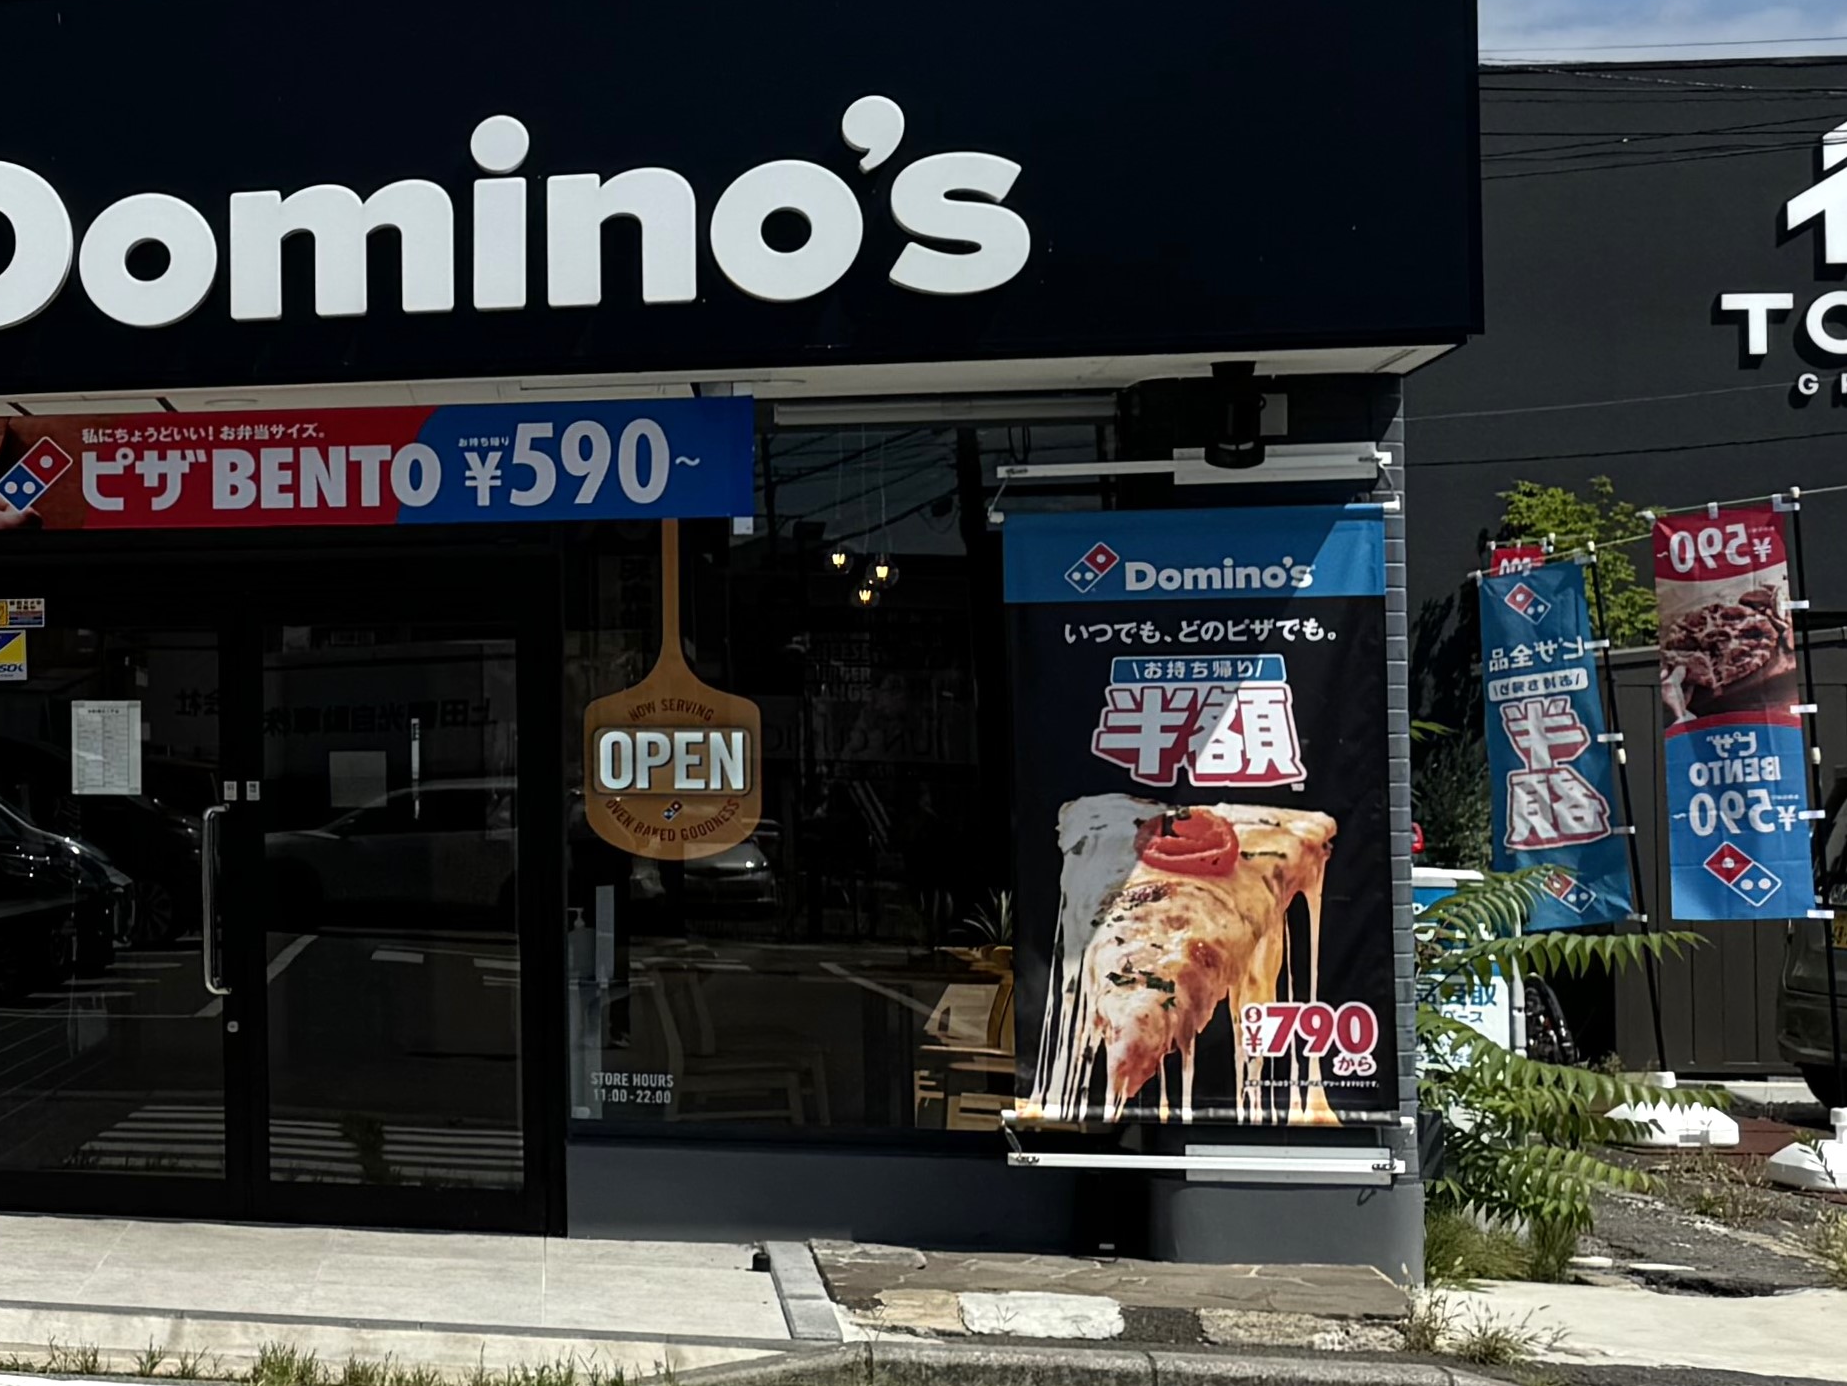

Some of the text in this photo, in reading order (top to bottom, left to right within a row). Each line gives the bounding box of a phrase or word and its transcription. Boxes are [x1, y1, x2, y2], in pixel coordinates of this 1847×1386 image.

[220, 423, 325, 441] お弁当サイズ。
[1125, 556, 1315, 591] Domino's
[1064, 617, 1337, 644] いつでも、どのピザでも。
[628, 698, 715, 722] NOW SERVING
[1094, 684, 1304, 781] 半額
[599, 729, 746, 791] OPEN
[605, 798, 740, 842] OVEN BAKED GOODNESS
[1337, 1056, 1373, 1072] から
[589, 1071, 674, 1088] STORE HOURS
